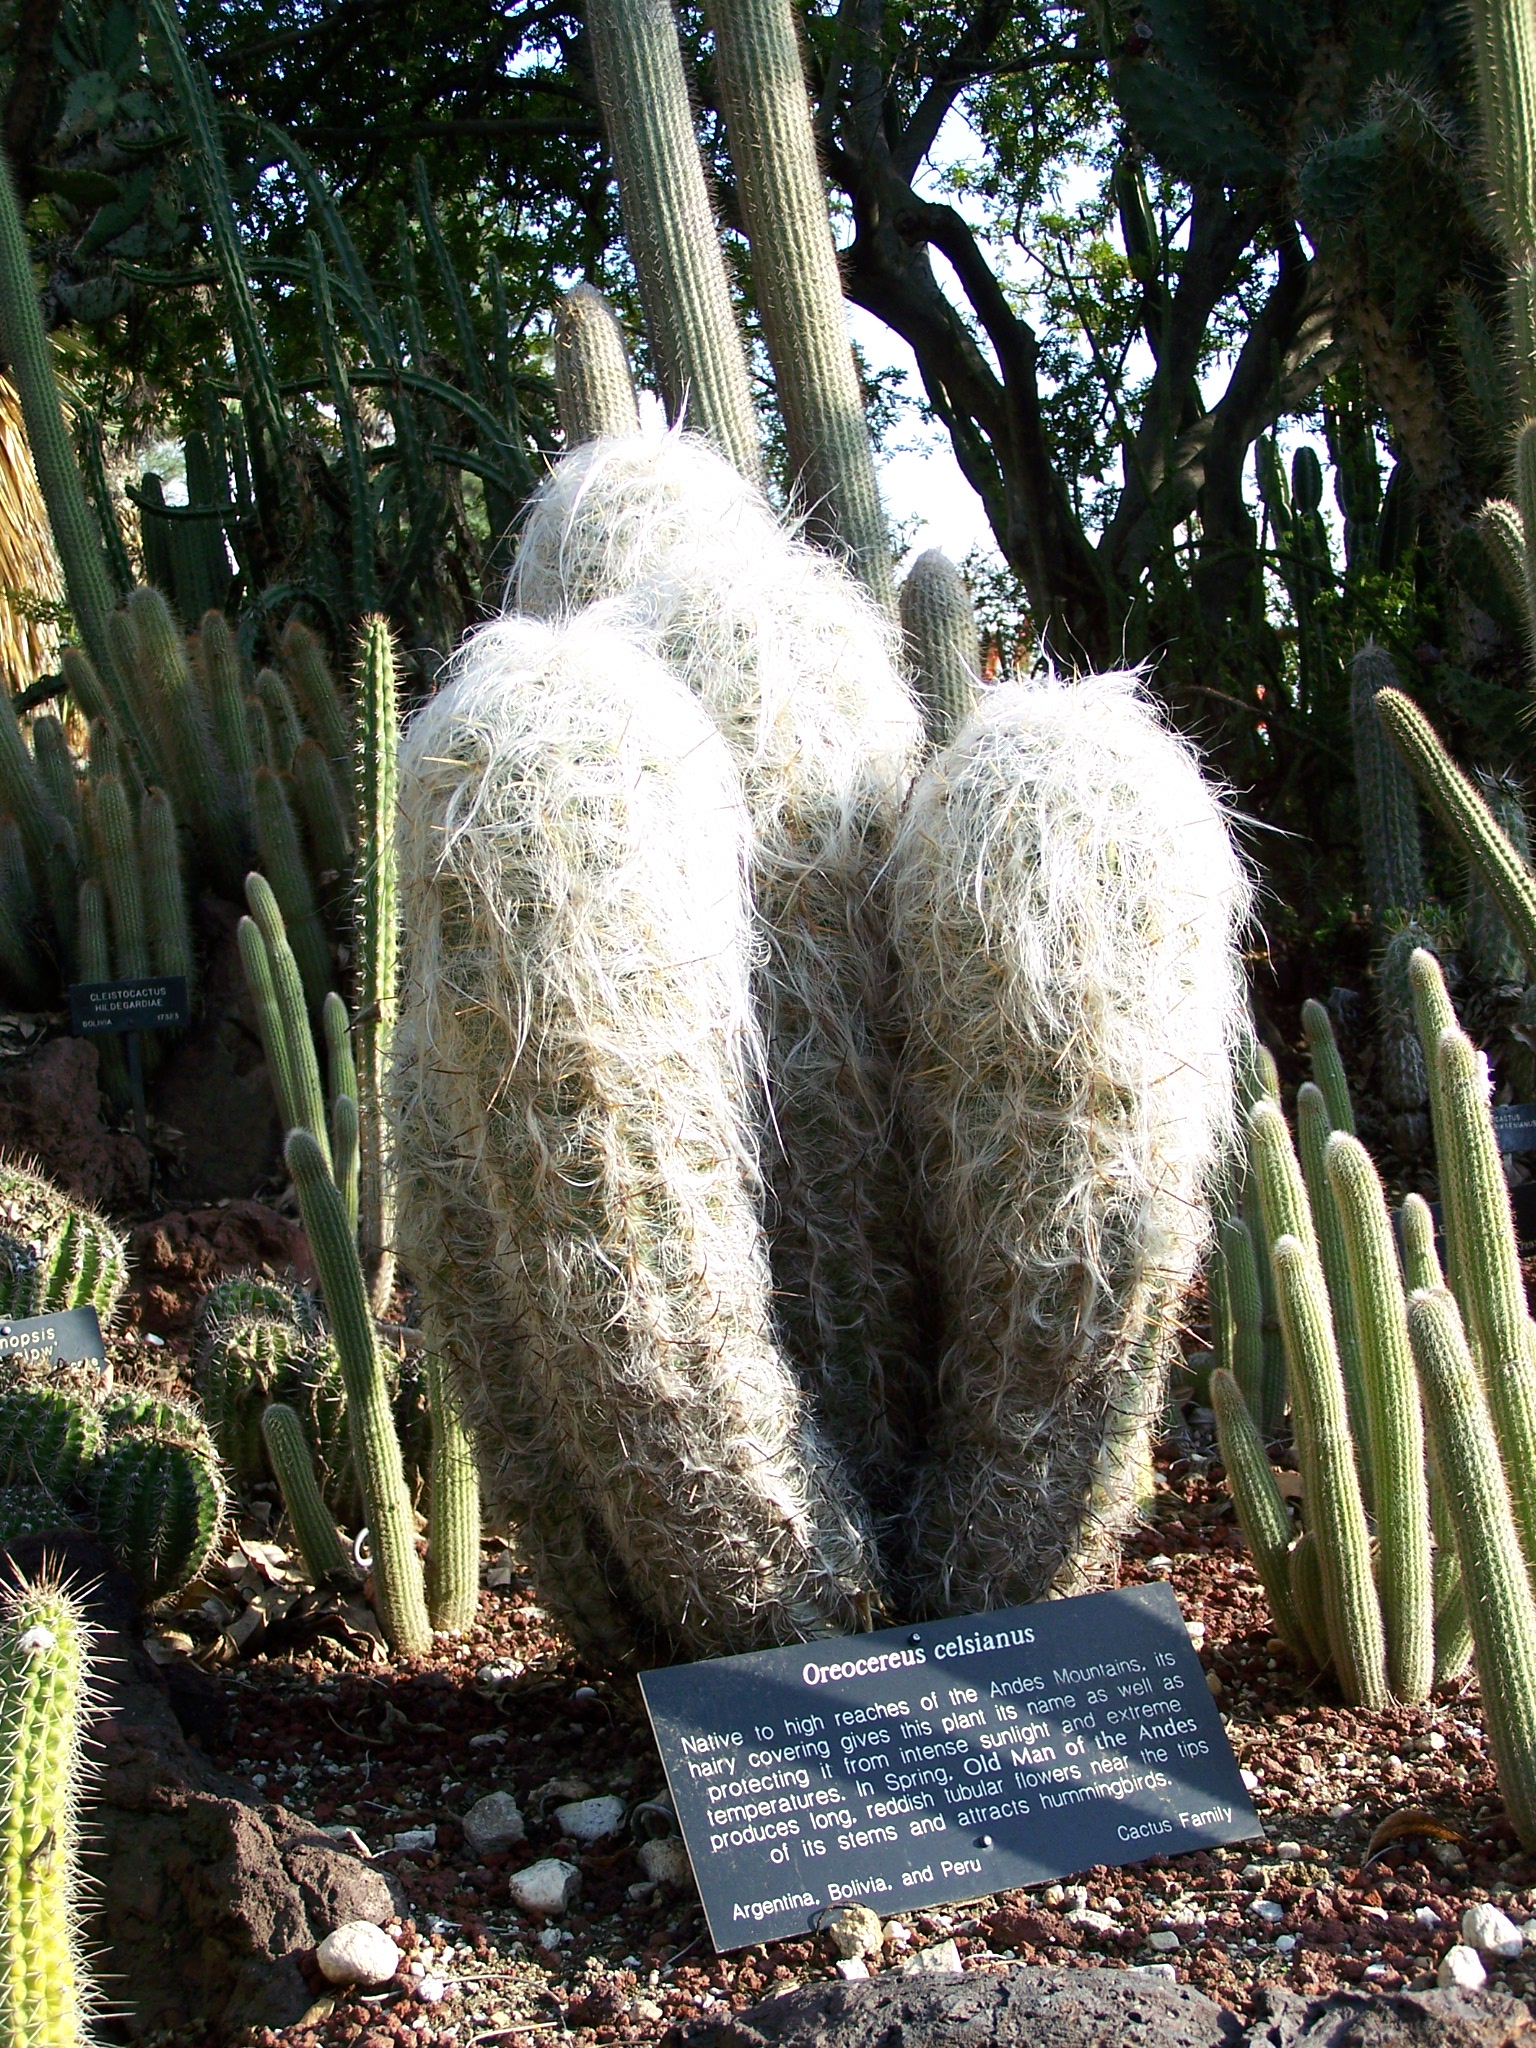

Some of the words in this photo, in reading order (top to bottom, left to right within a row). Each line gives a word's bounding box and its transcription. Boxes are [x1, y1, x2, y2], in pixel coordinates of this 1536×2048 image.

[82, 1018, 112, 1028] BOLIVIA
[90, 987, 166, 1002] CLEISTOCACTUS
[95, 998, 162, 1012] HILDEGARDIAE
[803, 1648, 926, 1685] Oreocereus
[934, 1627, 1035, 1660] celsianus
[681, 1731, 744, 1754] Native
[755, 1725, 774, 1741] to
[784, 1714, 825, 1736] high
[834, 1700, 910, 1726] reaches
[920, 1691, 939, 1711] of
[949, 1687, 978, 1706] the
[990, 1675, 1045, 1698] Andes
[1154, 1651, 1176, 1667] its
[688, 1757, 735, 1778] hairy
[748, 1740, 830, 1767] covering
[840, 1729, 890, 1754] gives
[900, 1719, 932, 1739] this
[941, 1709, 986, 1734] plant
[995, 1704, 1018, 1722] its
[1027, 1694, 1076, 1716] name
[1086, 1688, 1108, 1704] as
[1117, 1677, 1152, 1697] well
[1163, 1674, 1184, 1691] as
[707, 1768, 810, 1803] protecting
[819, 1762, 833, 1779] it
[843, 1754, 890, 1775] from
[899, 1738, 968, 1764] intense
[980, 1721, 1050, 1750] sunlight
[1062, 1712, 1095, 1734] and
[1106, 1698, 1182, 1724] extreme
[707, 1788, 845, 1826] temperatures.
[856, 1780, 875, 1798] In
[963, 1752, 1001, 1776] Old
[1011, 1746, 1056, 1767] Man
[1064, 1735, 1086, 1756] of
[1094, 1730, 1127, 1750] the
[1139, 1717, 1197, 1741] Andes
[709, 1819, 800, 1853] produces
[866, 1791, 935, 1819] reddish
[944, 1779, 1003, 1803] tubular
[1015, 1763, 1082, 1789] flowers
[1090, 1754, 1130, 1775] near
[1140, 1746, 1168, 1765] the
[1177, 1739, 1209, 1758] tips
[770, 1842, 790, 1864] of
[801, 1839, 826, 1857] its
[837, 1825, 898, 1850] stems
[909, 1813, 946, 1836] and
[958, 1798, 1030, 1826] attracts
[1039, 1770, 1172, 1809] hummingbirds.
[1117, 1818, 1172, 1841] Cactus
[1178, 1805, 1232, 1829] Family
[901, 1866, 934, 1886] and
[940, 1858, 982, 1878] Peru
